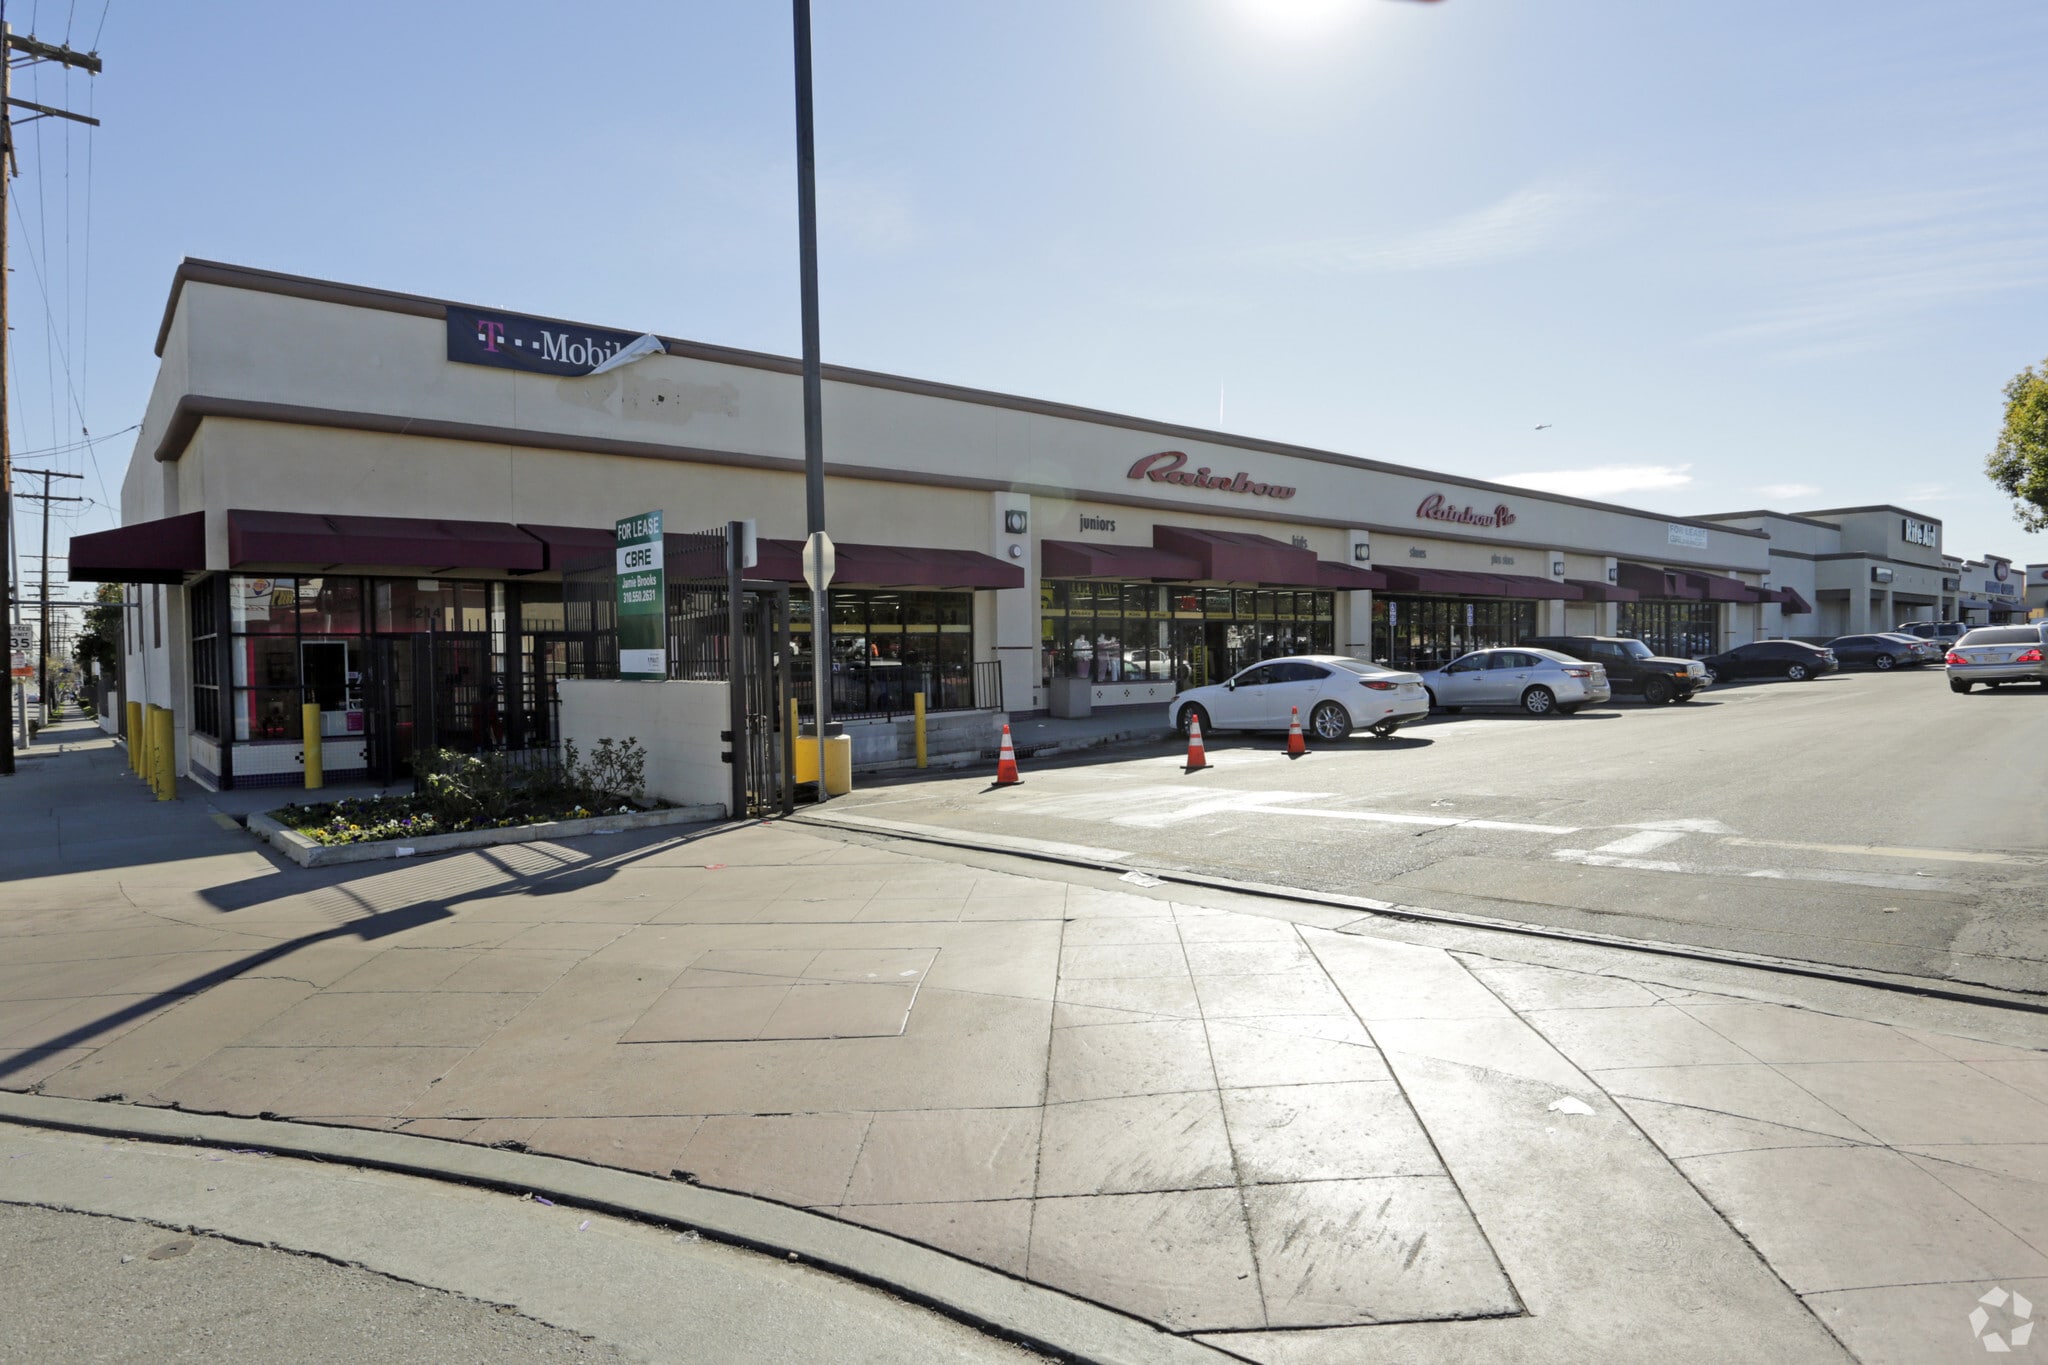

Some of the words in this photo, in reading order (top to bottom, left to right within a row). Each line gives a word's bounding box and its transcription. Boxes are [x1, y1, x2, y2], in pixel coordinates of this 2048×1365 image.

[540, 331, 622, 367] Mobil
[1127, 450, 1296, 500] Rainbow
[1416, 494, 1493, 527] Rainbow
[617, 522, 631, 541] FOR
[632, 517, 659, 538] LEASE
[1079, 513, 1116, 533] juniors
[1905, 519, 1923, 544] Rite
[1922, 524, 1936, 547] Aid
[624, 548, 652, 568] CBRE
[622, 576, 637, 589] Jamie
[637, 574, 657, 588] Brooks
[10, 638, 30, 648] 35
